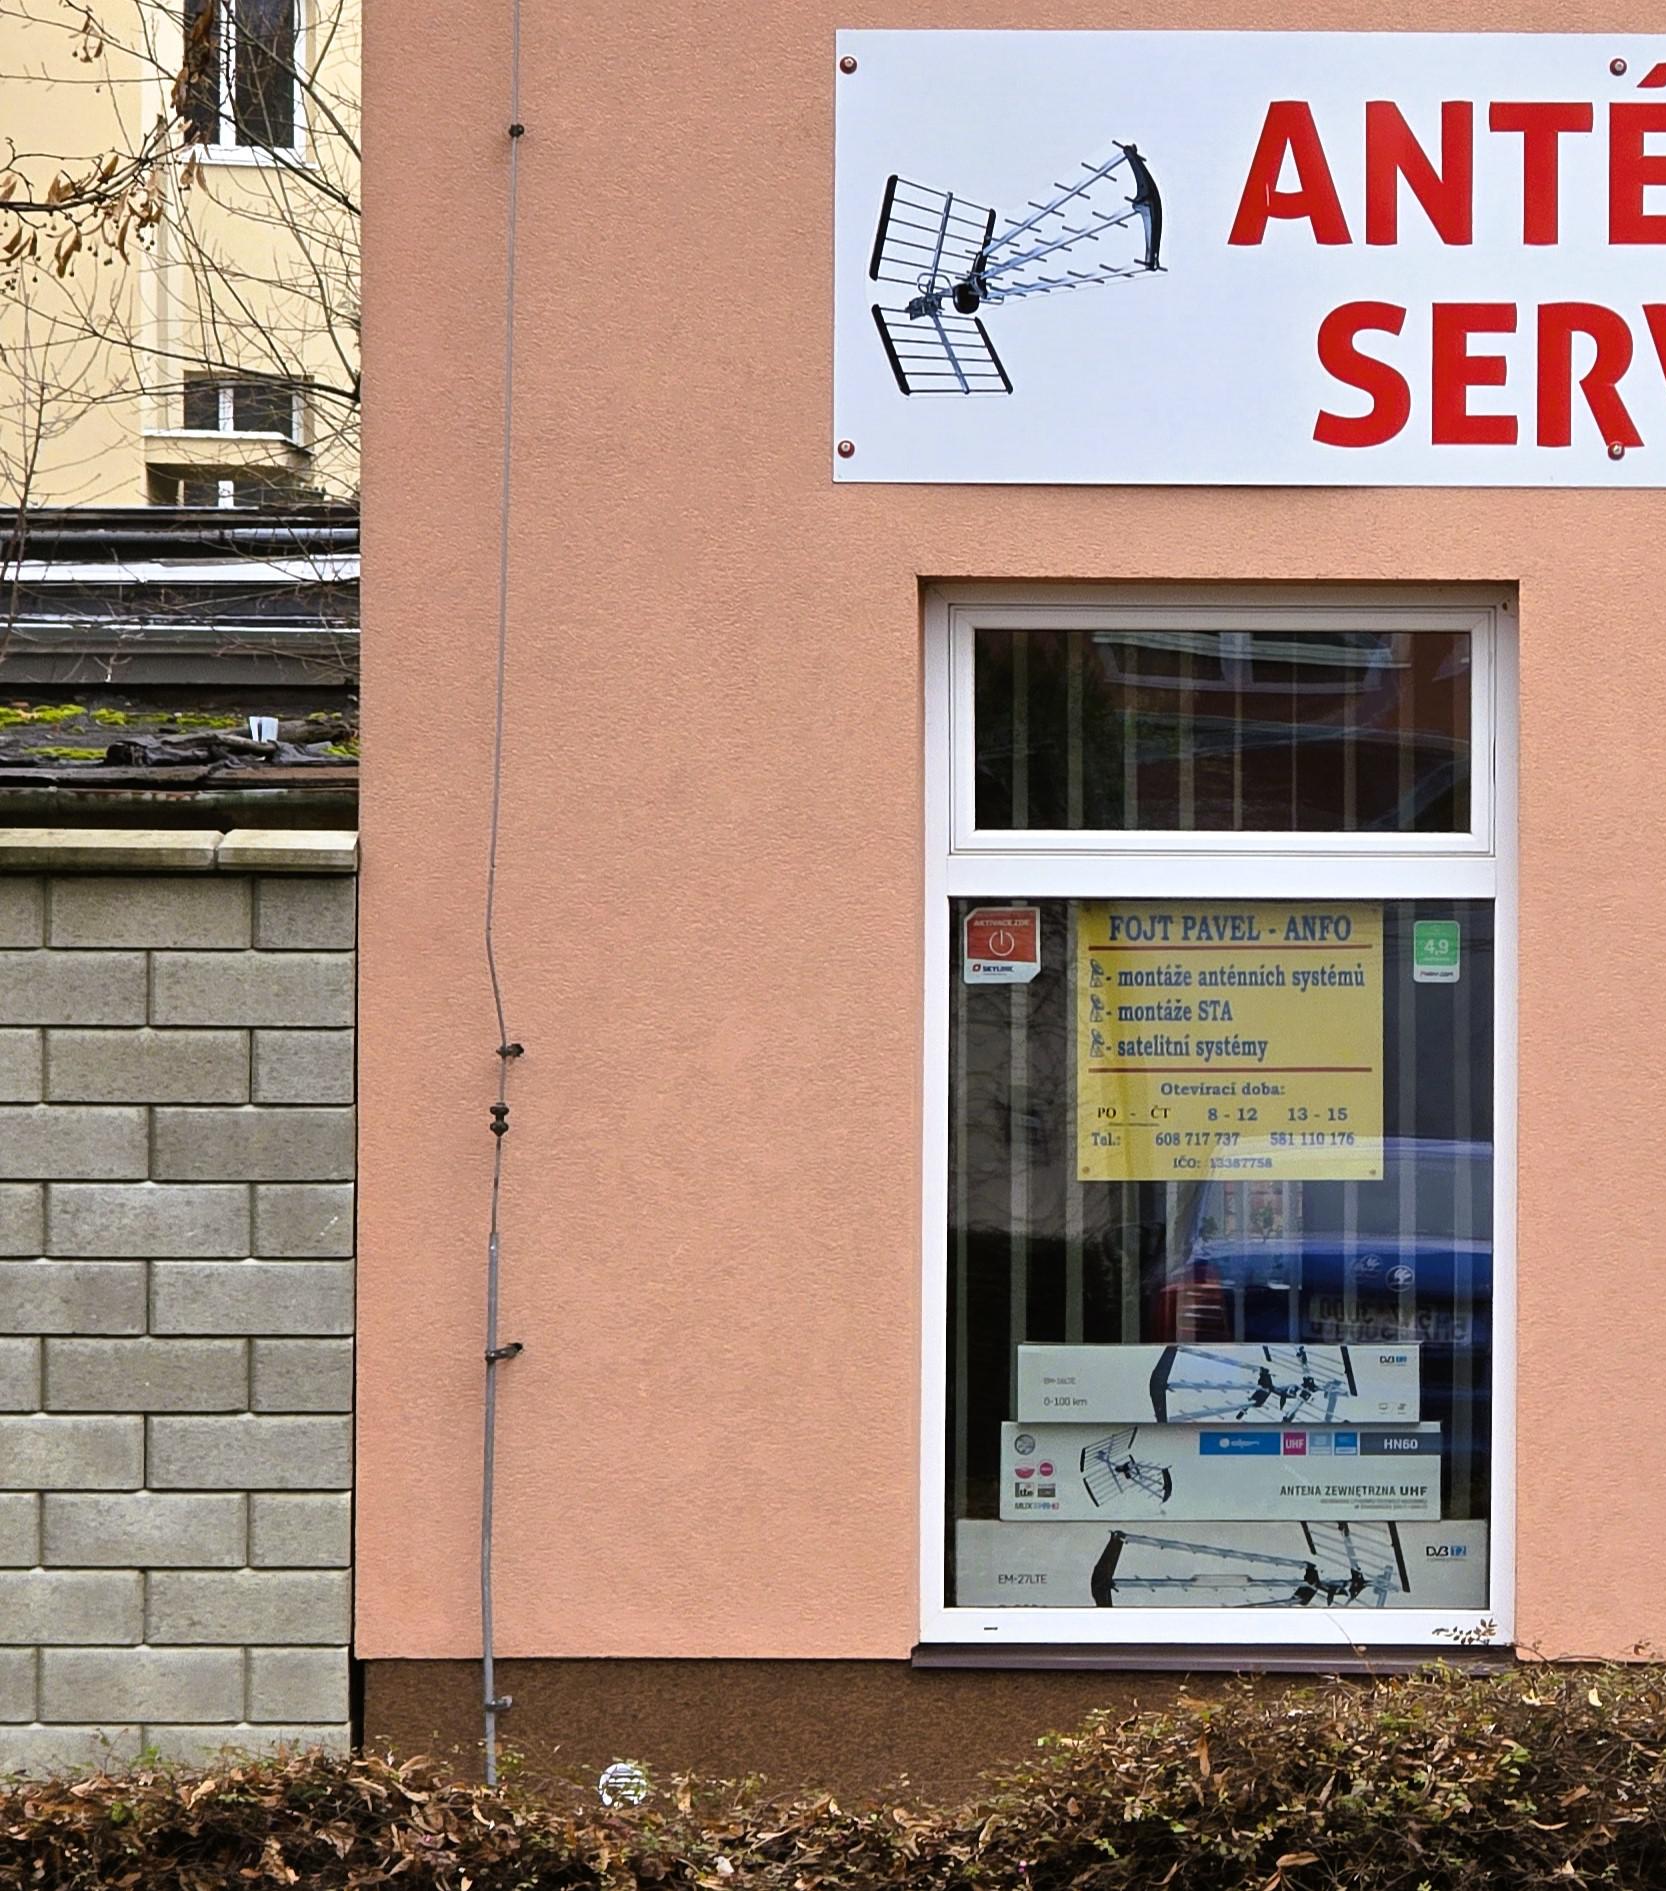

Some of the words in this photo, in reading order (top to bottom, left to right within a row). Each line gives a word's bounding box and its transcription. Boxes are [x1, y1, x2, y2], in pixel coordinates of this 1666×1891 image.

[1109, 914, 1174, 942] FOJT
[1181, 914, 1261, 942] PAVEL
[1283, 914, 1352, 942] ANFO
[1117, 964, 1192, 987] montáže
[1198, 964, 1286, 987] anténních
[1291, 962, 1366, 992] systémů
[1117, 999, 1192, 1022] montáže
[1198, 1000, 1233, 1022] STA
[1117, 1034, 1190, 1057] satelitní
[1195, 1034, 1269, 1062] systémy
[1241, 1082, 1286, 1096] doba:
[1097, 1106, 1117, 1119] PO
[1150, 1105, 1171, 1119] ČT
[1207, 1107, 1218, 1121] 8
[1237, 1107, 1258, 1121] 12
[1287, 1107, 1308, 1121] 13
[1327, 1107, 1348, 1121] 15
[1091, 1132, 1121, 1146] Tel.:
[1155, 1132, 1181, 1146] 608
[1184, 1132, 1210, 1146] 717
[1215, 1132, 1240, 1146] 737
[1270, 1132, 1294, 1146] 581
[1300, 1132, 1325, 1146] 110
[1329, 1132, 1355, 1146] 176
[1173, 1156, 1201, 1169] IČO:
[1285, 1437, 1304, 1449] UHF
[1383, 1438, 1418, 1449] HN60
[1280, 1485, 1321, 1497] ANTENA
[1325, 1485, 1396, 1499] ZEWNĘTRZNA
[1400, 1486, 1428, 1497] UHF
[1425, 1545, 1449, 1557] DVB
[998, 1574, 1048, 1585] EM-27LTE
